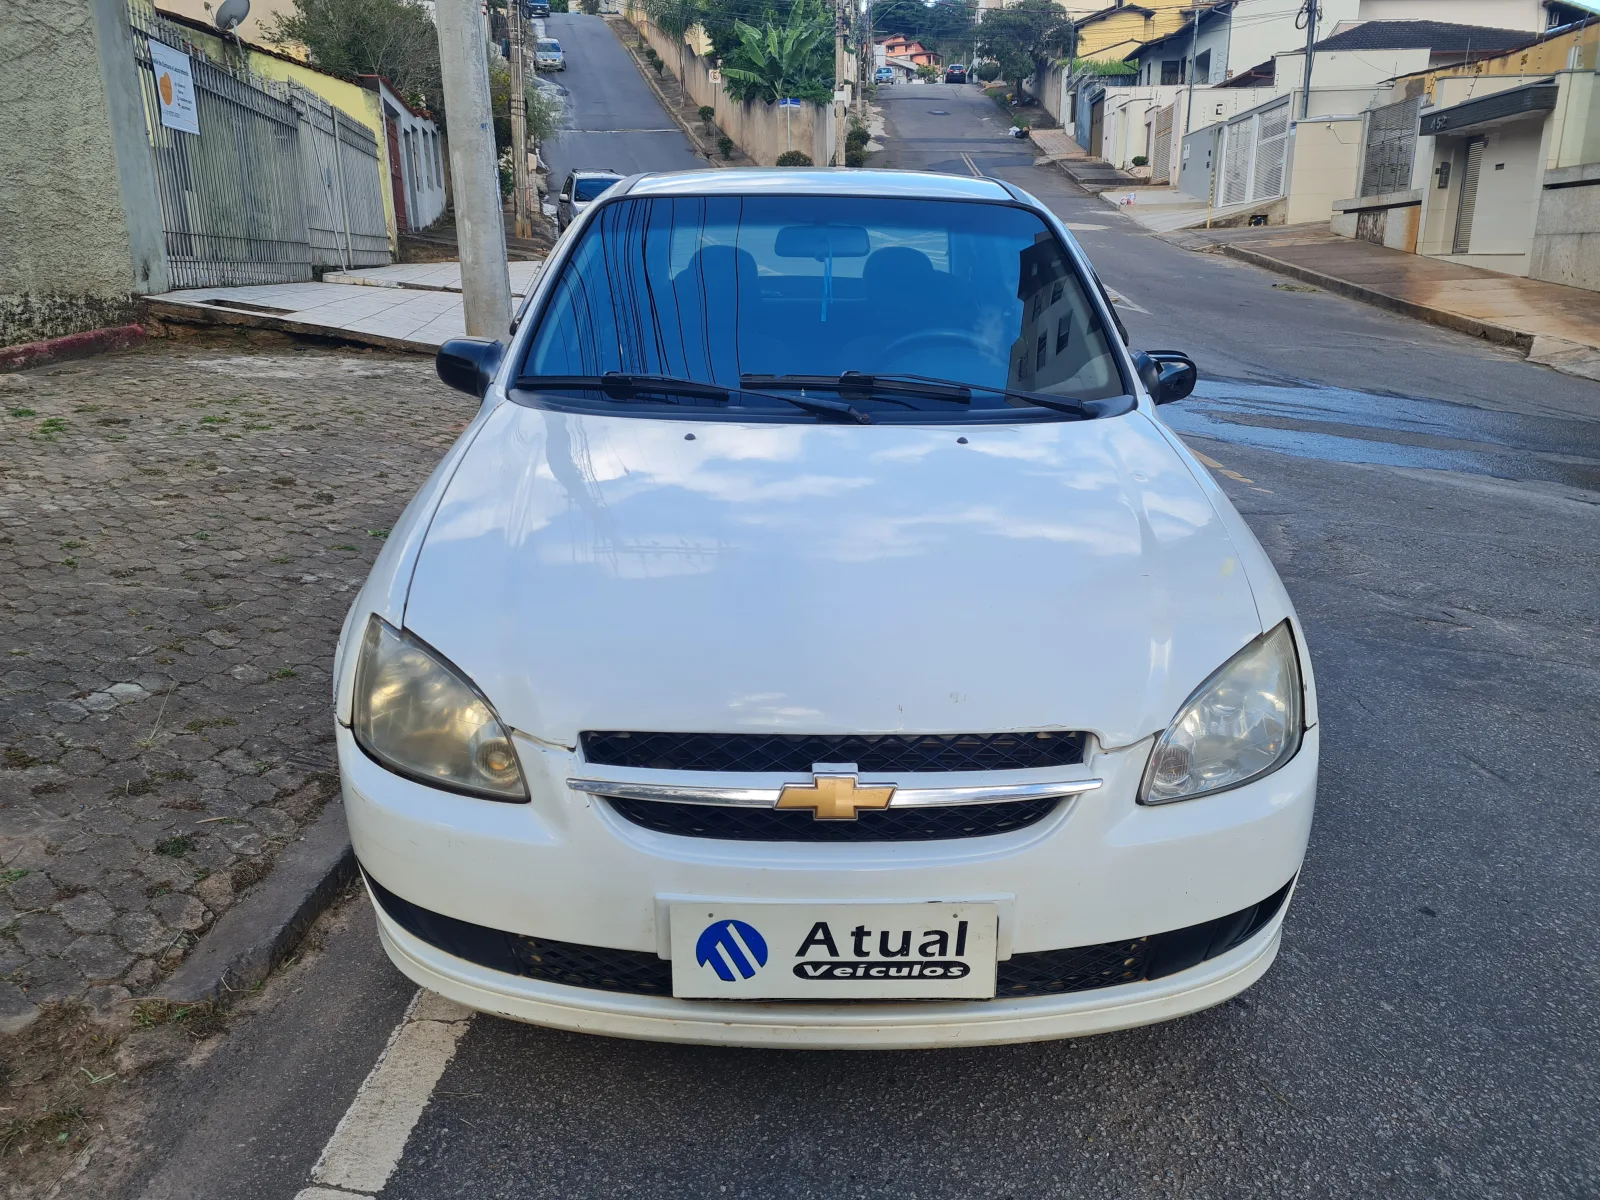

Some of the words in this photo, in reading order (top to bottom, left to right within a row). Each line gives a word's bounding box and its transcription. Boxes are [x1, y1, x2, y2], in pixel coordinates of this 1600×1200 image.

[1430, 116, 1447, 130] 452
[795, 921, 968, 957] Atual
[803, 963, 964, 977] Veículos
